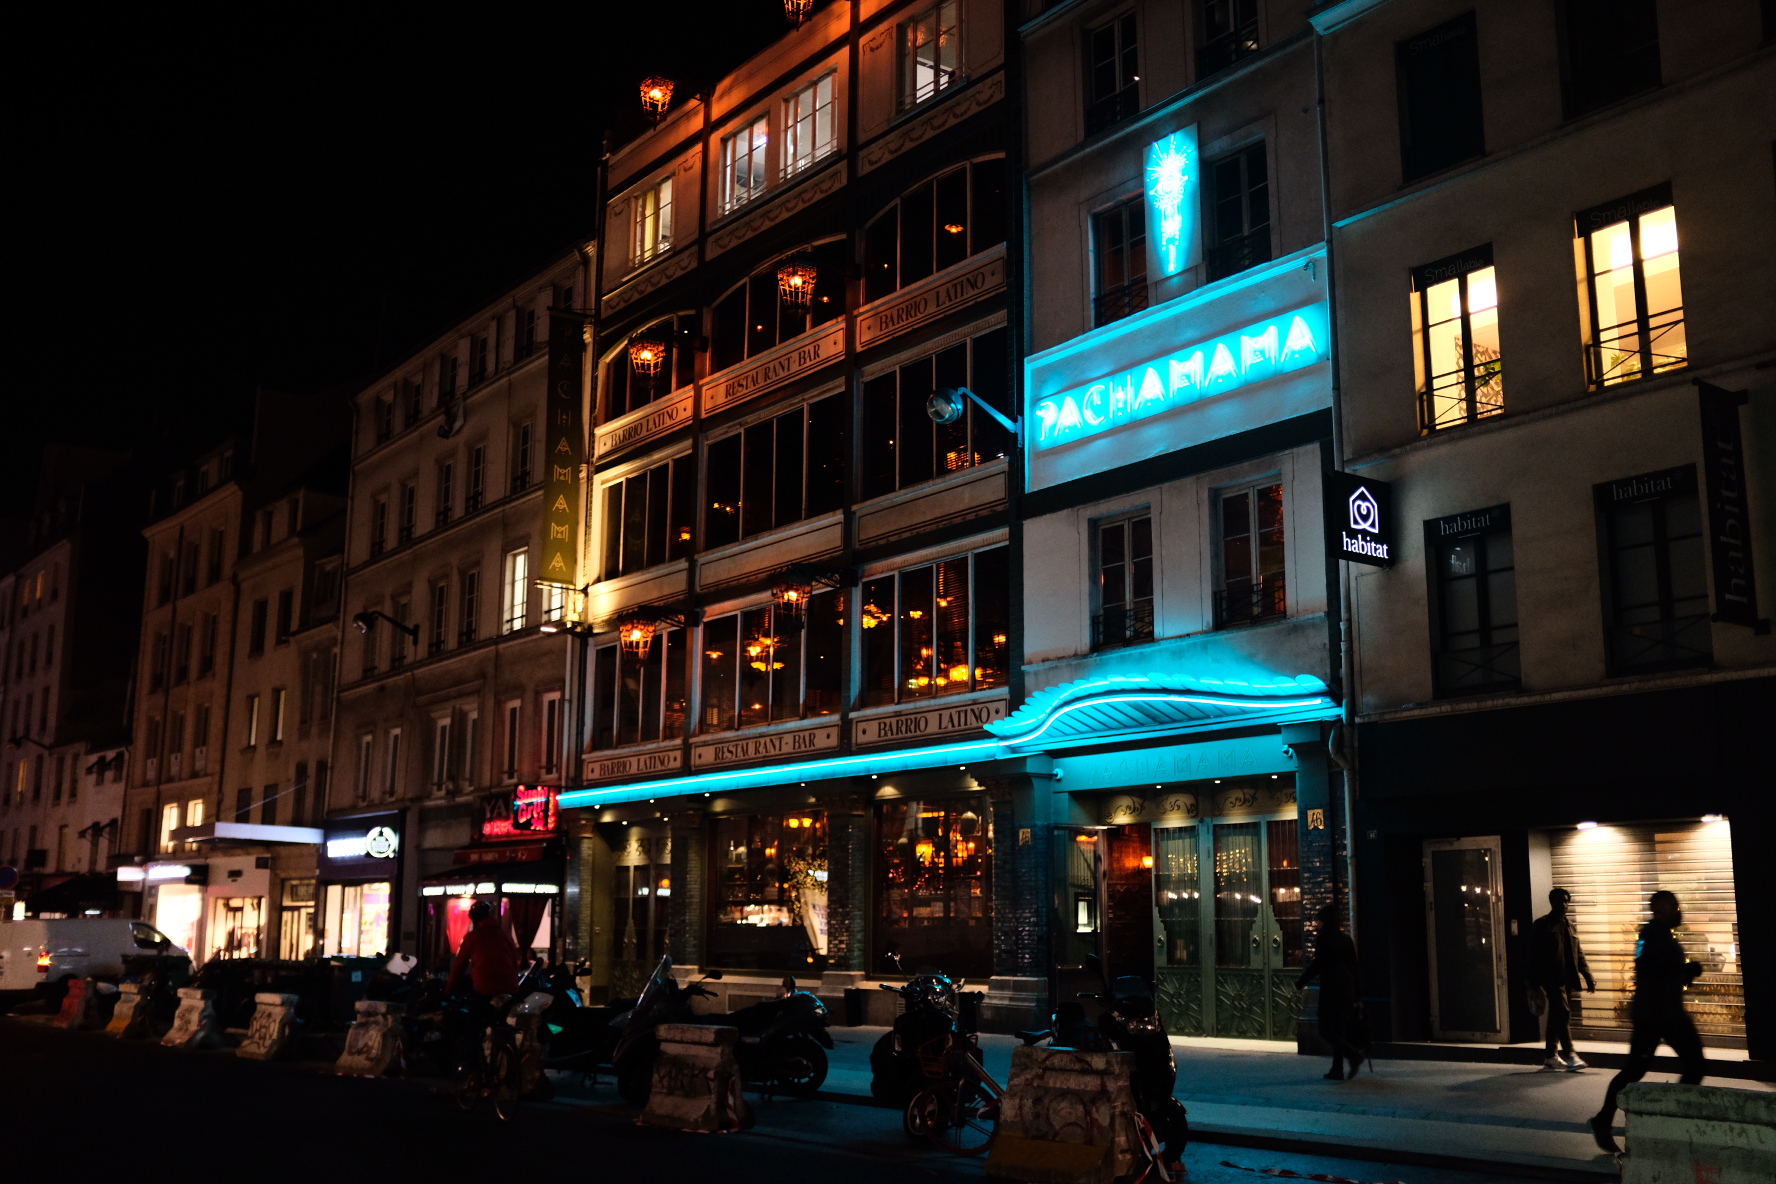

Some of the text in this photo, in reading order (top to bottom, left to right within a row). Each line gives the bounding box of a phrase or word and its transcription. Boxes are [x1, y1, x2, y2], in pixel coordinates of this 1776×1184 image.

[878, 271, 986, 333] BARRIO LATINO
[1036, 315, 1317, 441] PACHAMAMA
[610, 405, 678, 448] BARRIO LATINO
[1612, 475, 1673, 501] habitat
[1439, 512, 1492, 536] habitat
[1715, 430, 1748, 605] habitat
[1342, 531, 1389, 560] habitat
[878, 706, 990, 738] BARRIO LATINO
[599, 754, 671, 776] BARRIO LATINO
